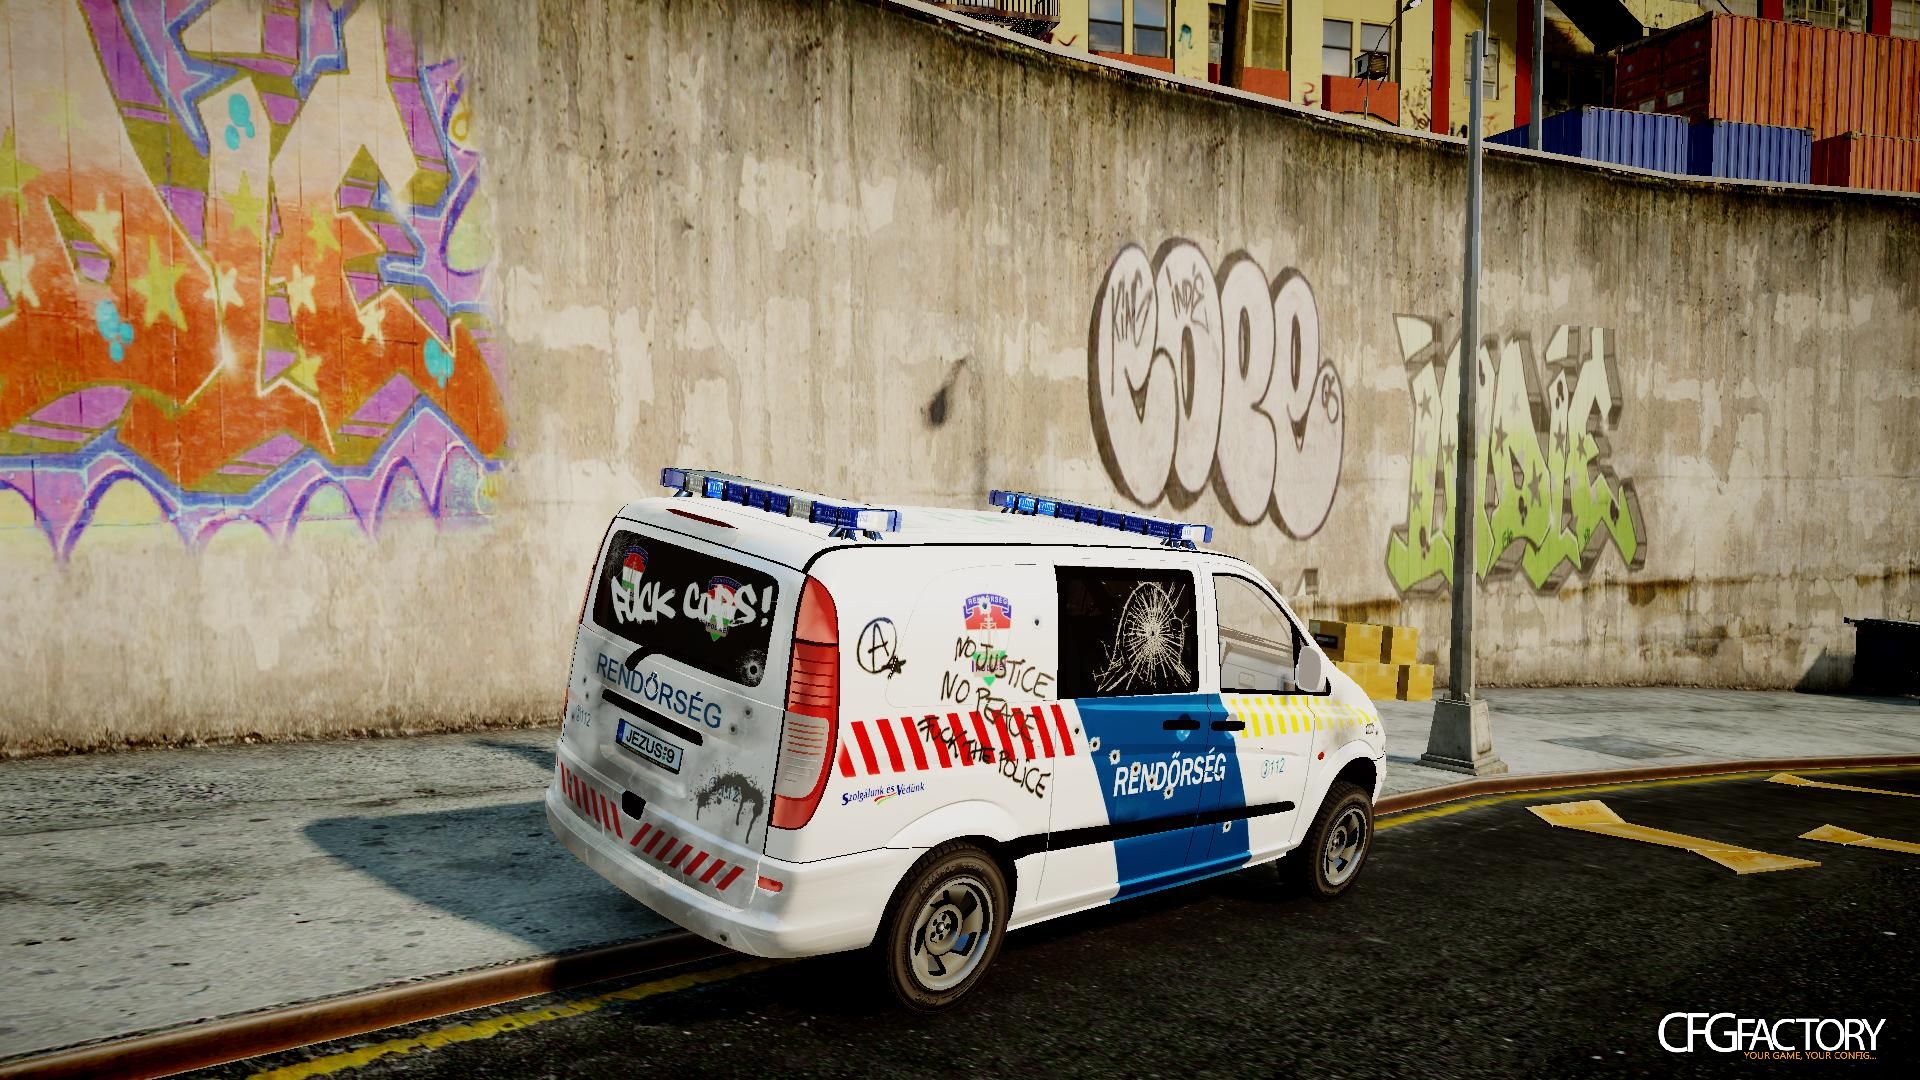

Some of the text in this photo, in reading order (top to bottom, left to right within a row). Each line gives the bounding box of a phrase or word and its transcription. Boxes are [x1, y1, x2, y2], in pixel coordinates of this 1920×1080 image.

[611, 575, 677, 625] FUCK
[954, 636, 1055, 699] NO JUSTICE
[940, 670, 1040, 743] NO PEACE
[916, 715, 1052, 799] FUCK THE POLICE
